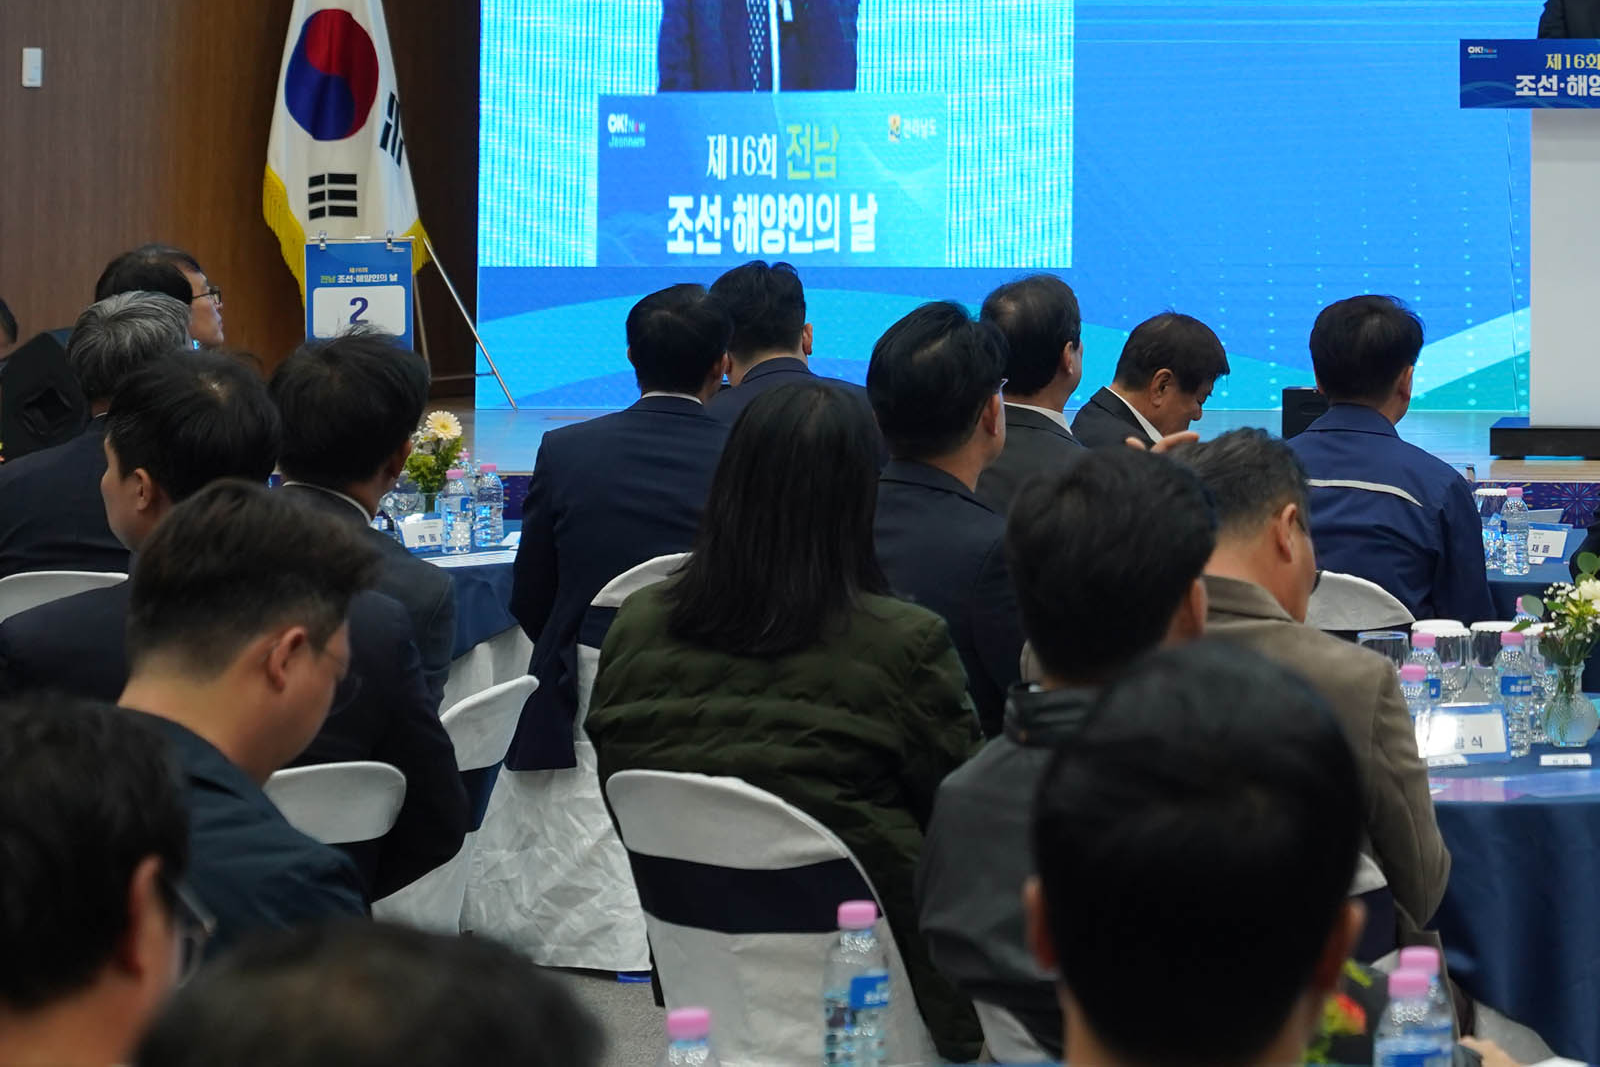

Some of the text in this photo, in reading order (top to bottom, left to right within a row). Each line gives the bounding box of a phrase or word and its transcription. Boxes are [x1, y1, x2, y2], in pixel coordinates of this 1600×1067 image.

[1545, 53, 1600, 70] 제16회
[706, 125, 839, 179] 제16회 전남
[850, 193, 878, 253] 날
[350, 297, 368, 325] 2
